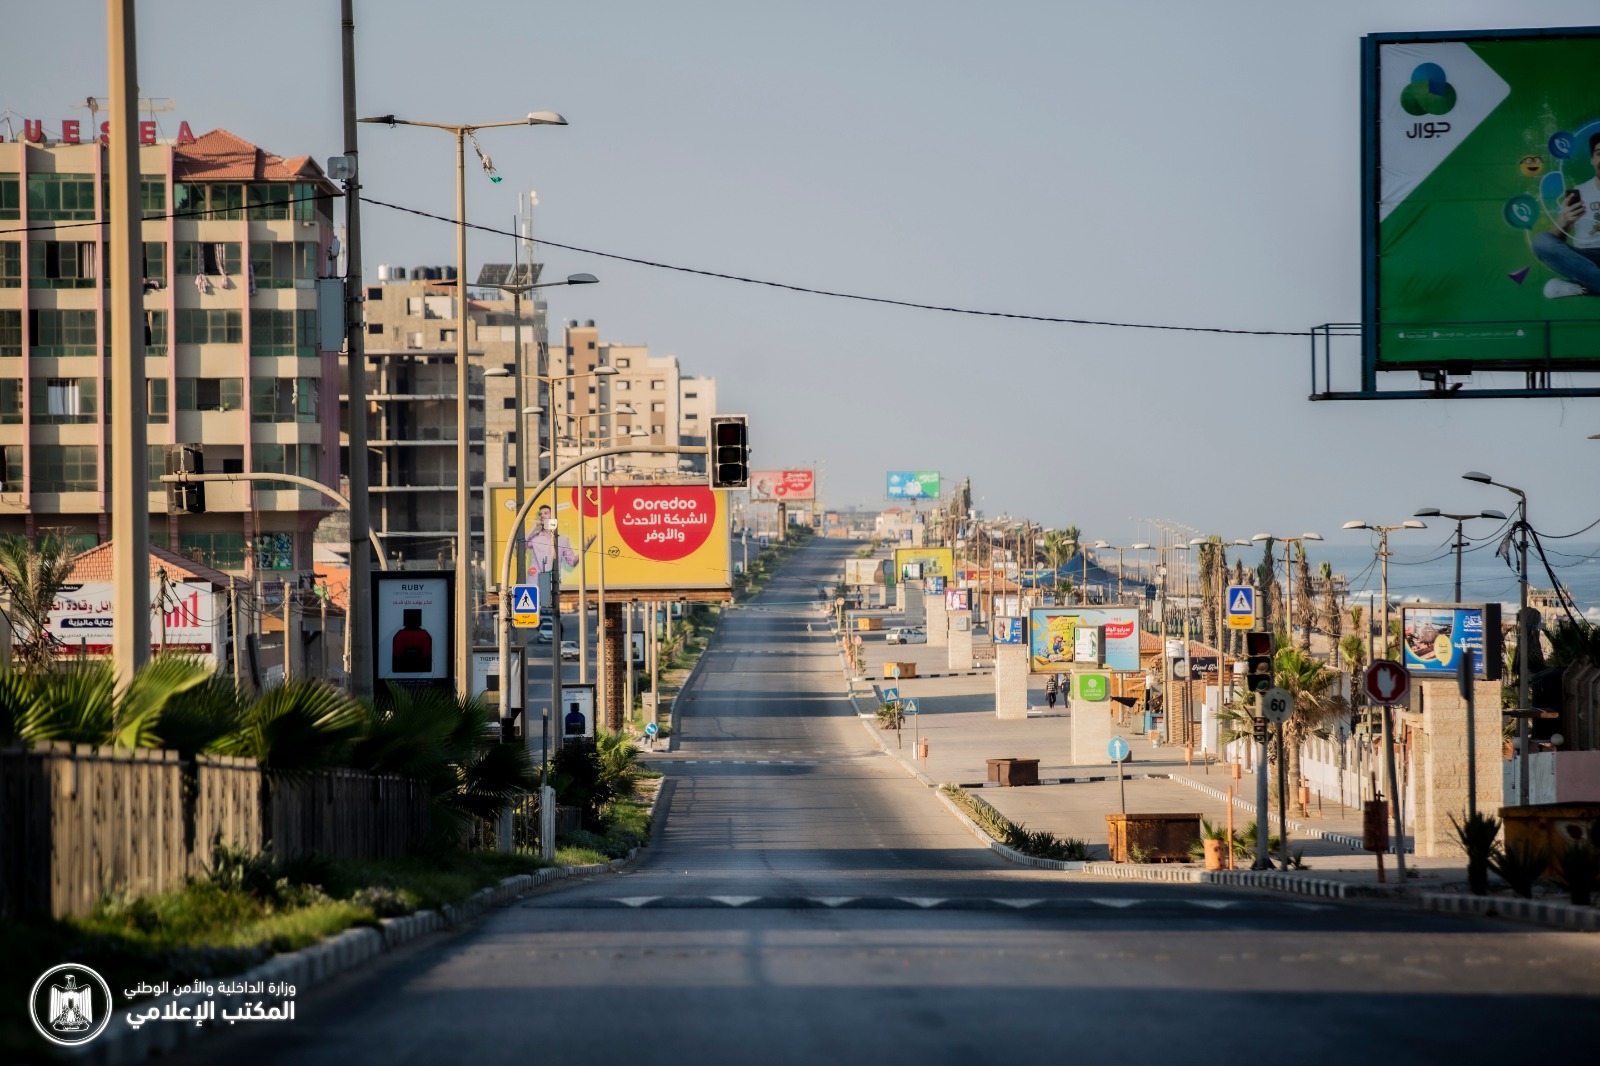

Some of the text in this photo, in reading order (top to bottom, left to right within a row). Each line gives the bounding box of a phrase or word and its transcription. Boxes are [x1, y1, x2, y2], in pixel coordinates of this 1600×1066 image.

[1406, 121, 1451, 139] جوال
[632, 496, 697, 511] Ooredoo
[622, 512, 708, 527] الشبكة الأحدث
[643, 528, 686, 543] والأوفر
[68, 618, 94, 627] ماليزية
[1270, 698, 1286, 712] 60
